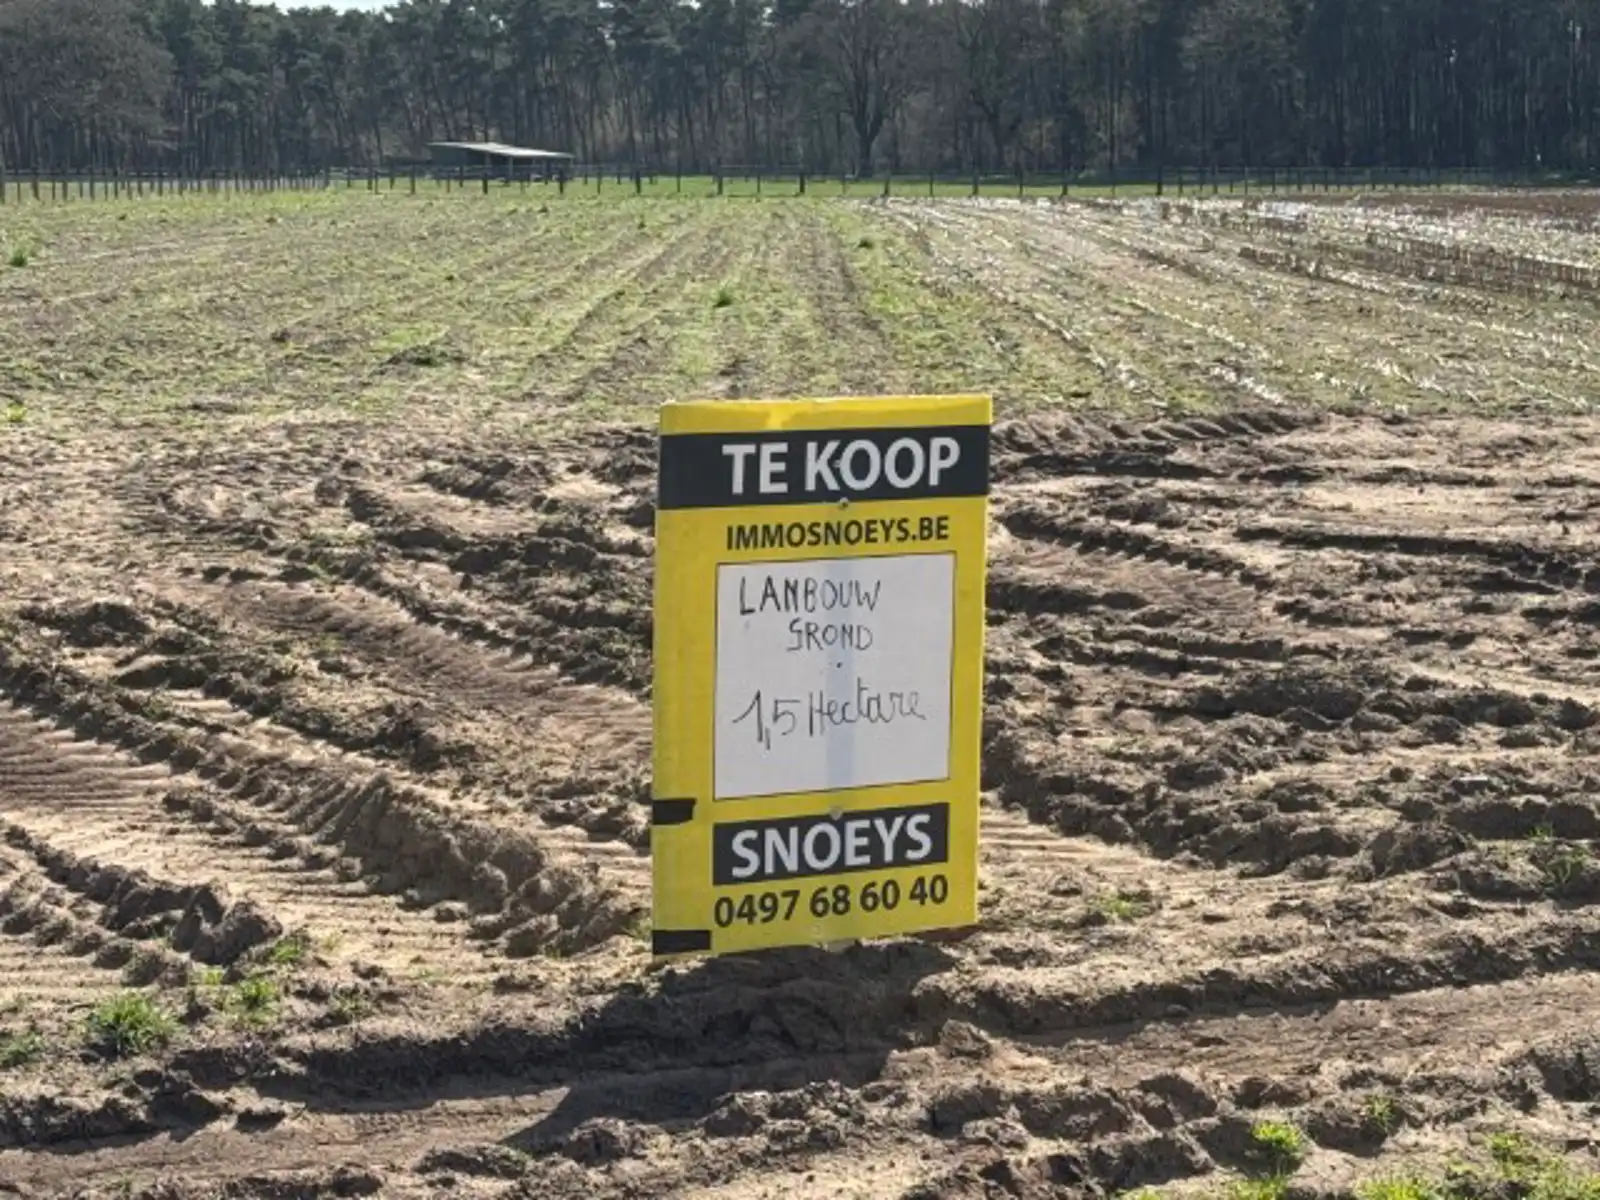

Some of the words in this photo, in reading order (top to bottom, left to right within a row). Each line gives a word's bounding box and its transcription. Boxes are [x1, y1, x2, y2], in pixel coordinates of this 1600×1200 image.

[722, 442, 788, 495] TE
[805, 437, 960, 491] KOOP
[726, 516, 949, 550] IMMOSNOEYS.BE
[732, 689, 801, 750] 1,5
[808, 676, 926, 737] Hectare
[731, 813, 932, 878] SNOEYS
[714, 889, 800, 927] 0497
[809, 884, 851, 918] 68
[859, 879, 900, 911] 60
[909, 874, 949, 905] 40
